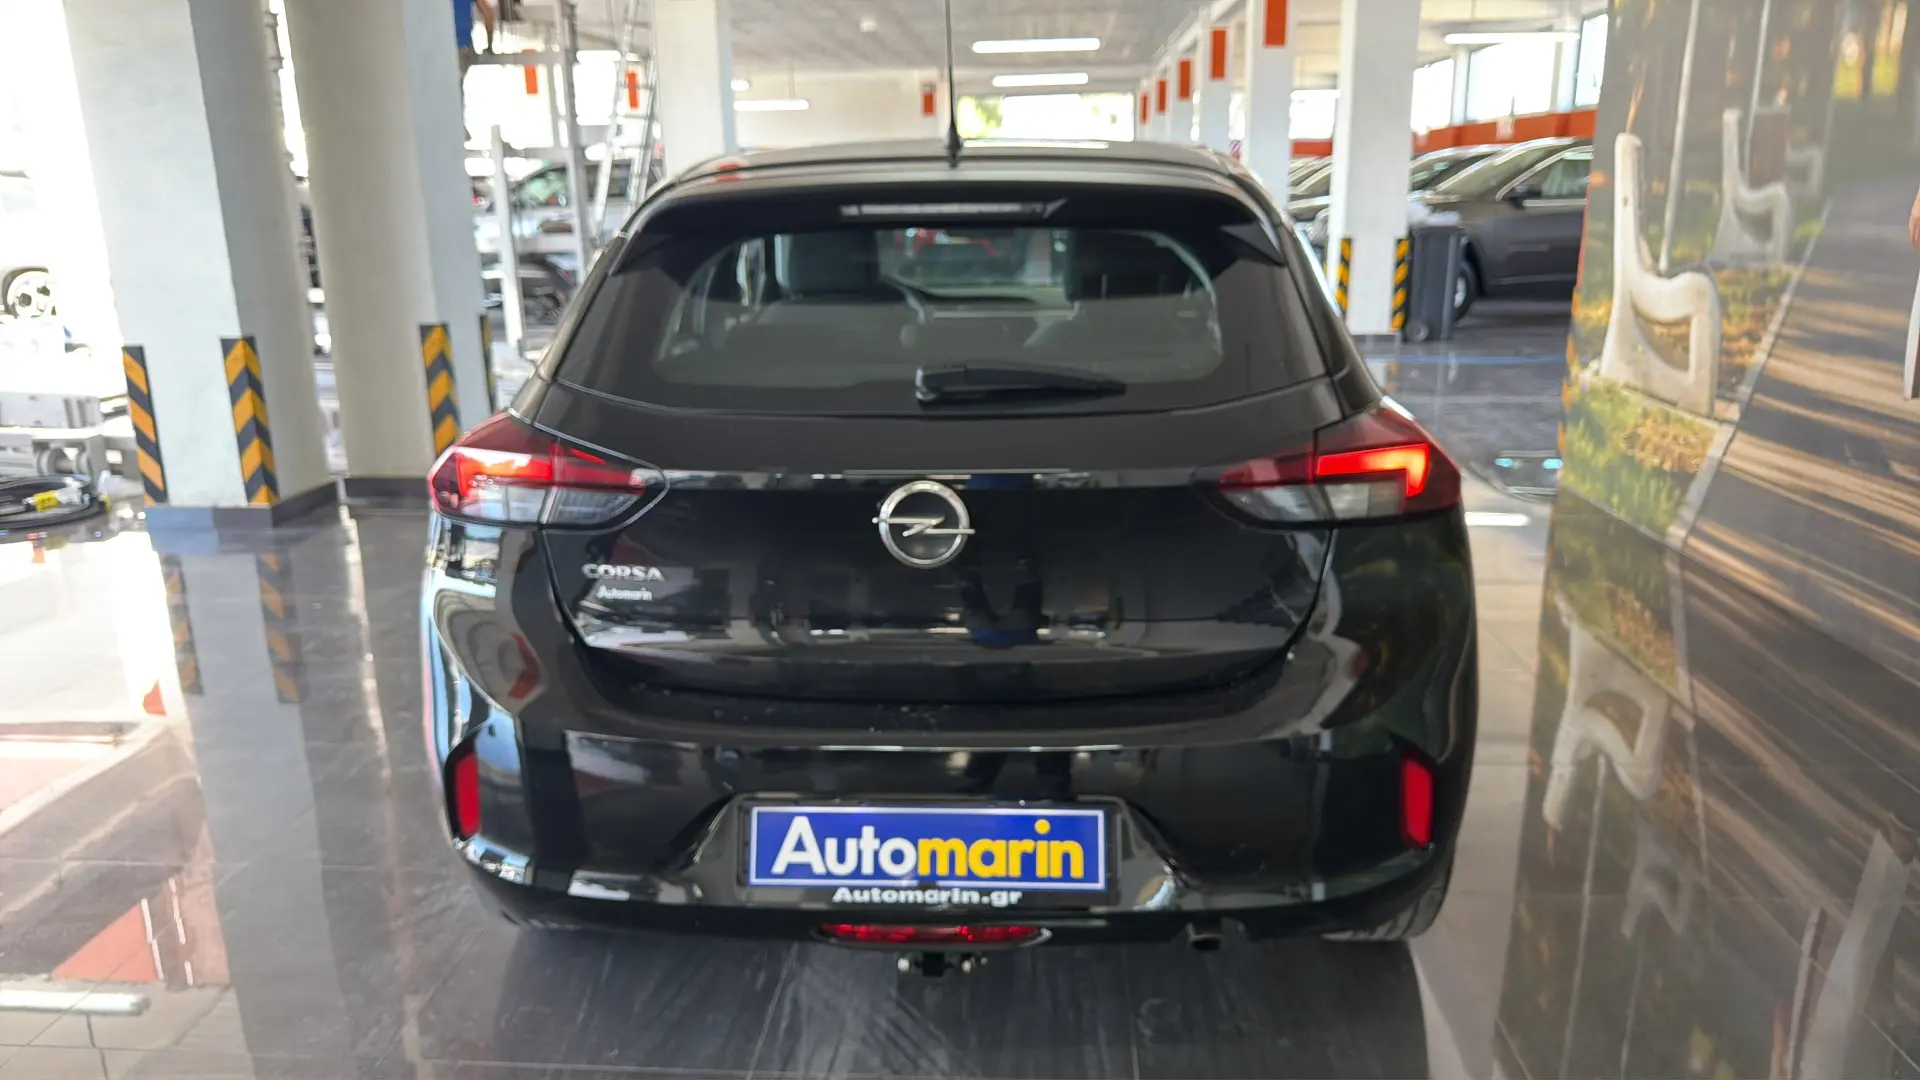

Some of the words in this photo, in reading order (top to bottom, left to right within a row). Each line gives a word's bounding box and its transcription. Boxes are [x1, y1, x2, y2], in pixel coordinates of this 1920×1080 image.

[581, 563, 665, 581] CORSA
[597, 585, 652, 601] Automarin
[771, 816, 1084, 879] Automarin
[832, 886, 1023, 907] Automarin.gr
